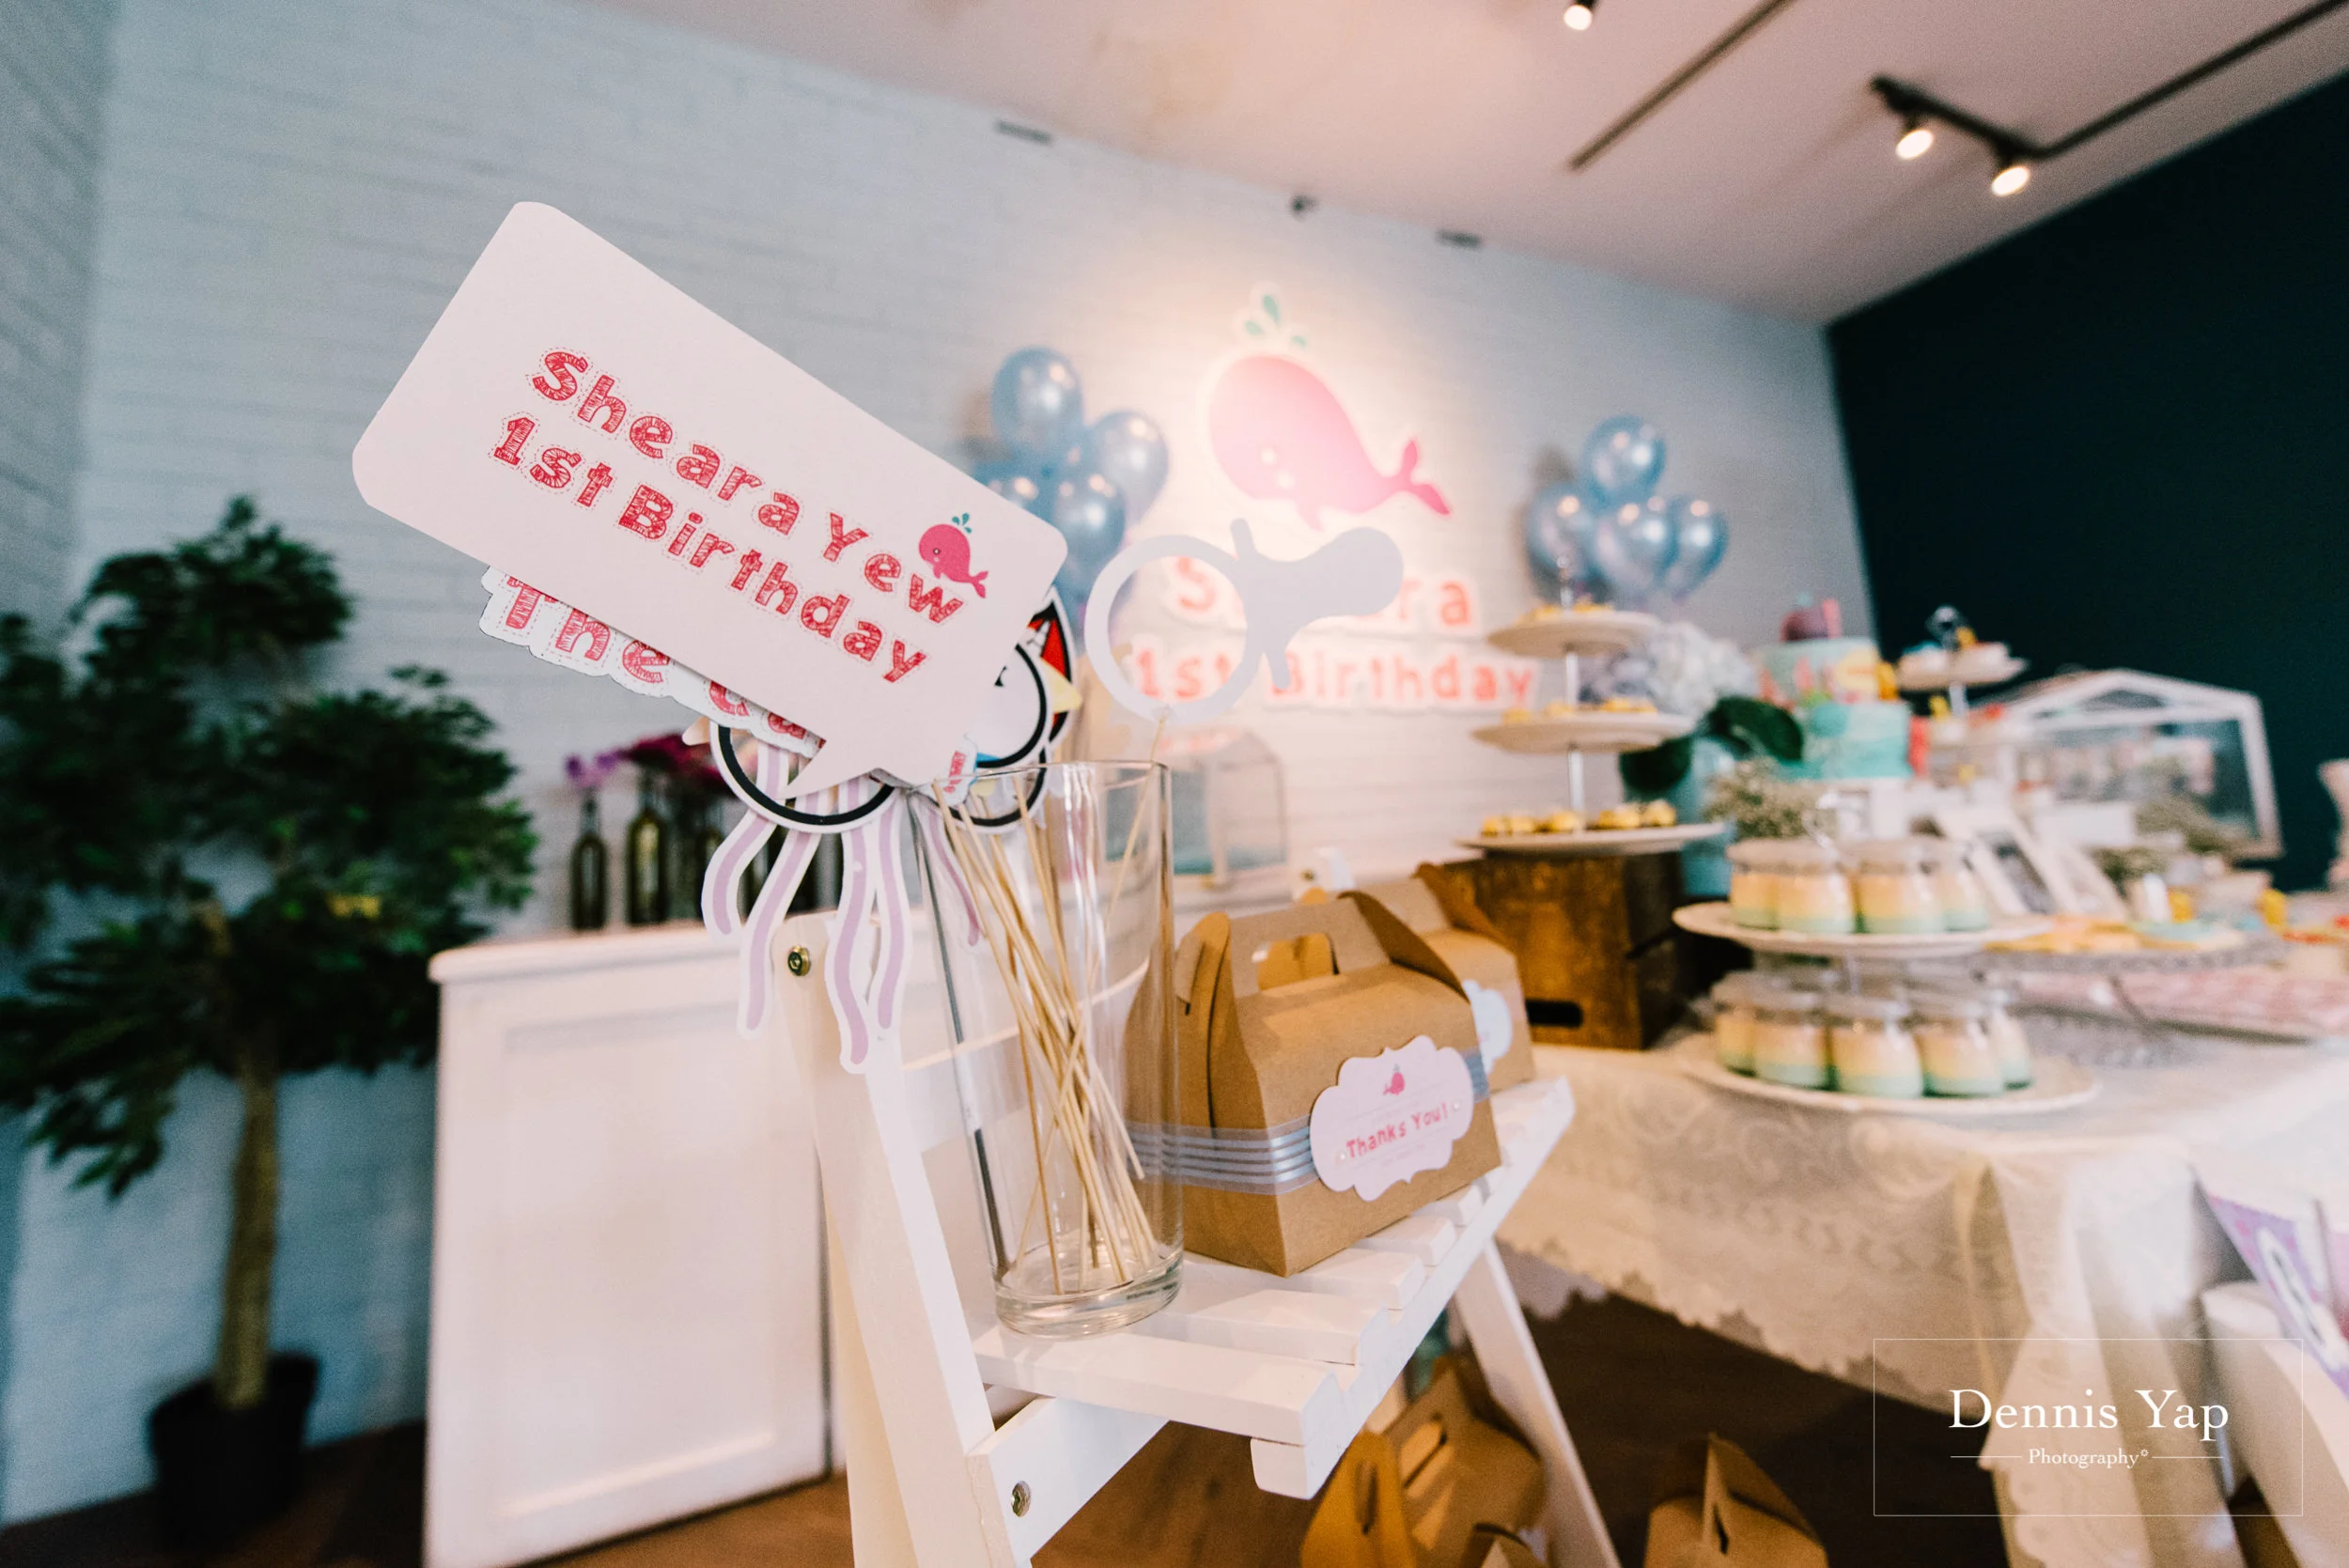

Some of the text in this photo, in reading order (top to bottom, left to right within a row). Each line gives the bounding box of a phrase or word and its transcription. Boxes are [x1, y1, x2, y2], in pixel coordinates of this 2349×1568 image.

[493, 416, 927, 684] 1st Birthday
[531, 350, 964, 624] Sheara Yew
[1346, 1121, 1408, 1158] Thanks
[1411, 1101, 1448, 1130] You!
